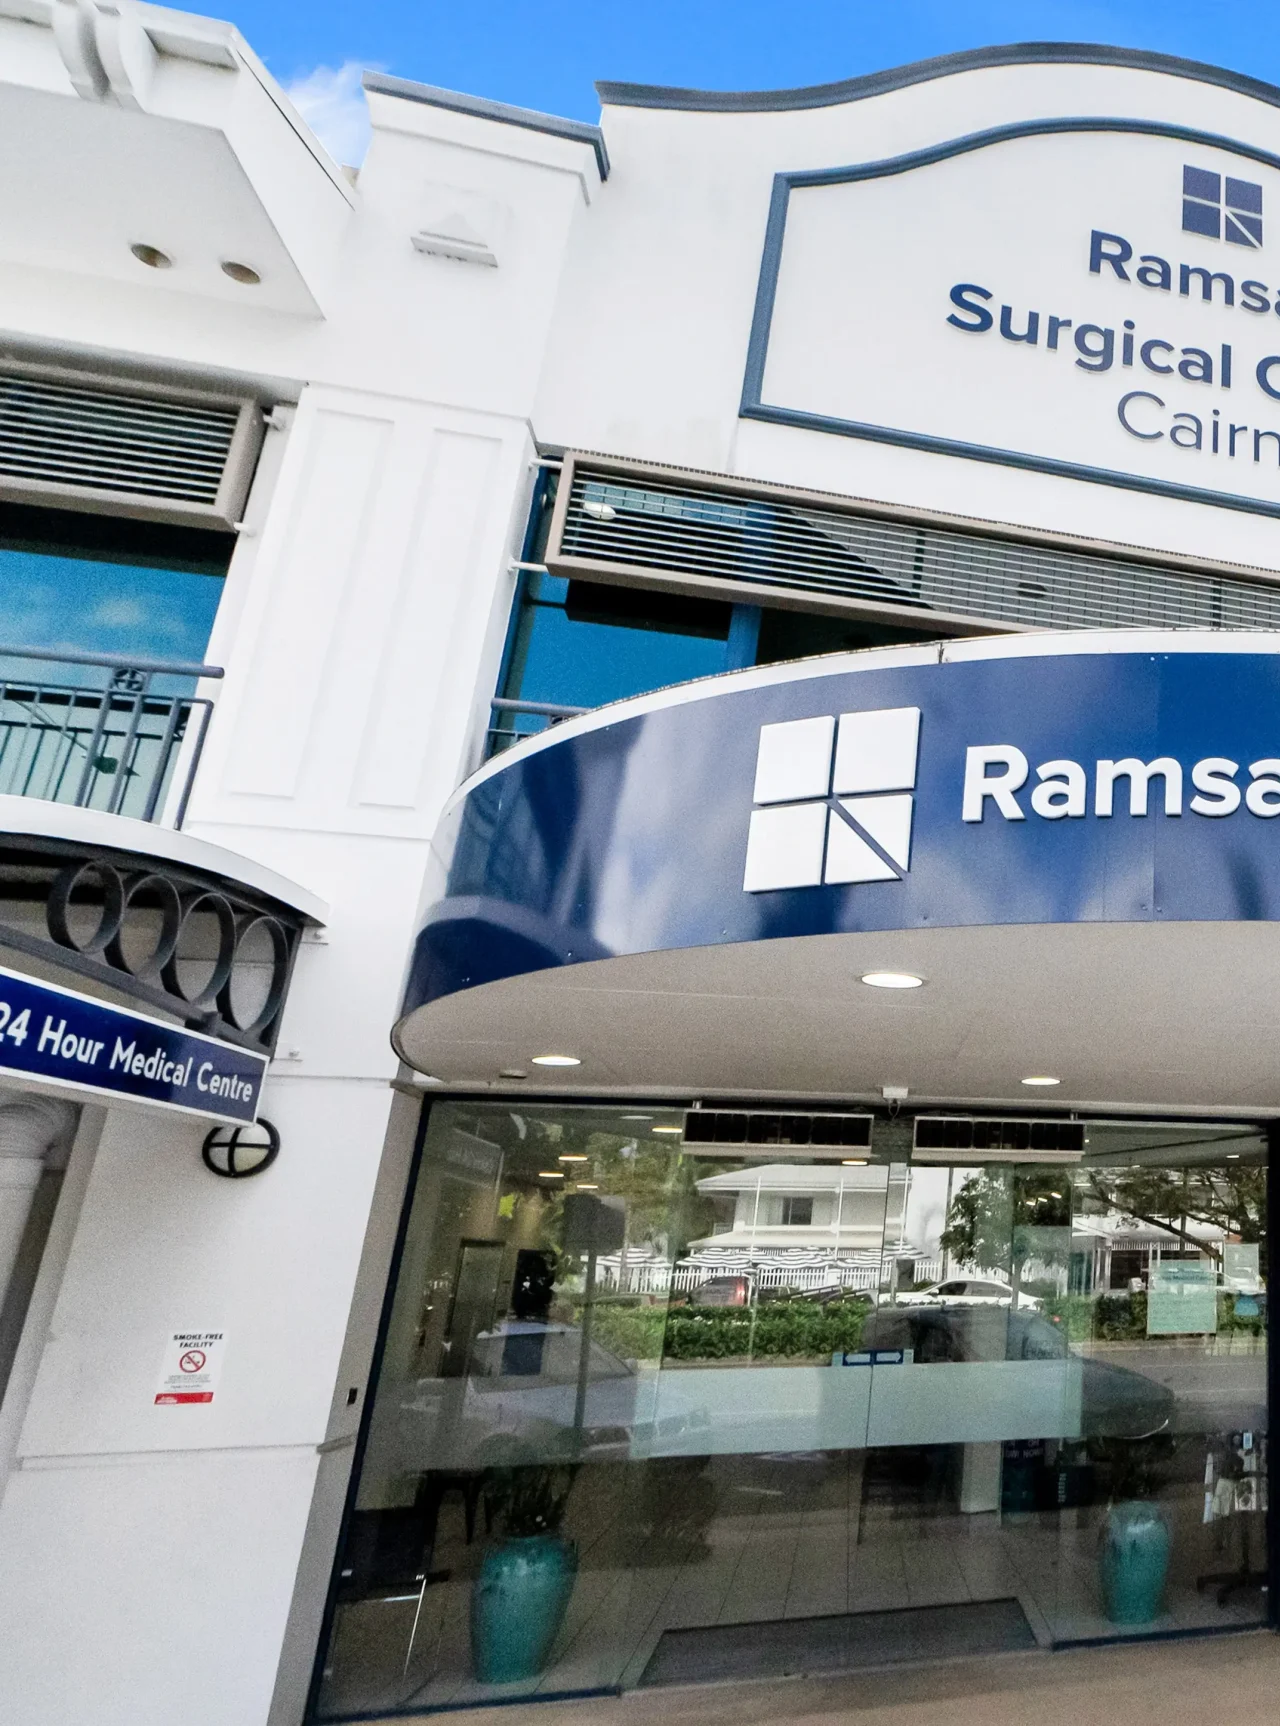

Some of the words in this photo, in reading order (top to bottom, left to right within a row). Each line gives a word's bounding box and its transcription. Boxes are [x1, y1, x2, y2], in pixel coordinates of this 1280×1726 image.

[945, 282, 1233, 389] Surgical
[37, 1015, 104, 1065] Hour
[109, 1036, 193, 1087] Medical
[197, 1062, 253, 1102] Centre
[173, 1333, 224, 1341] SMOKE-FREE
